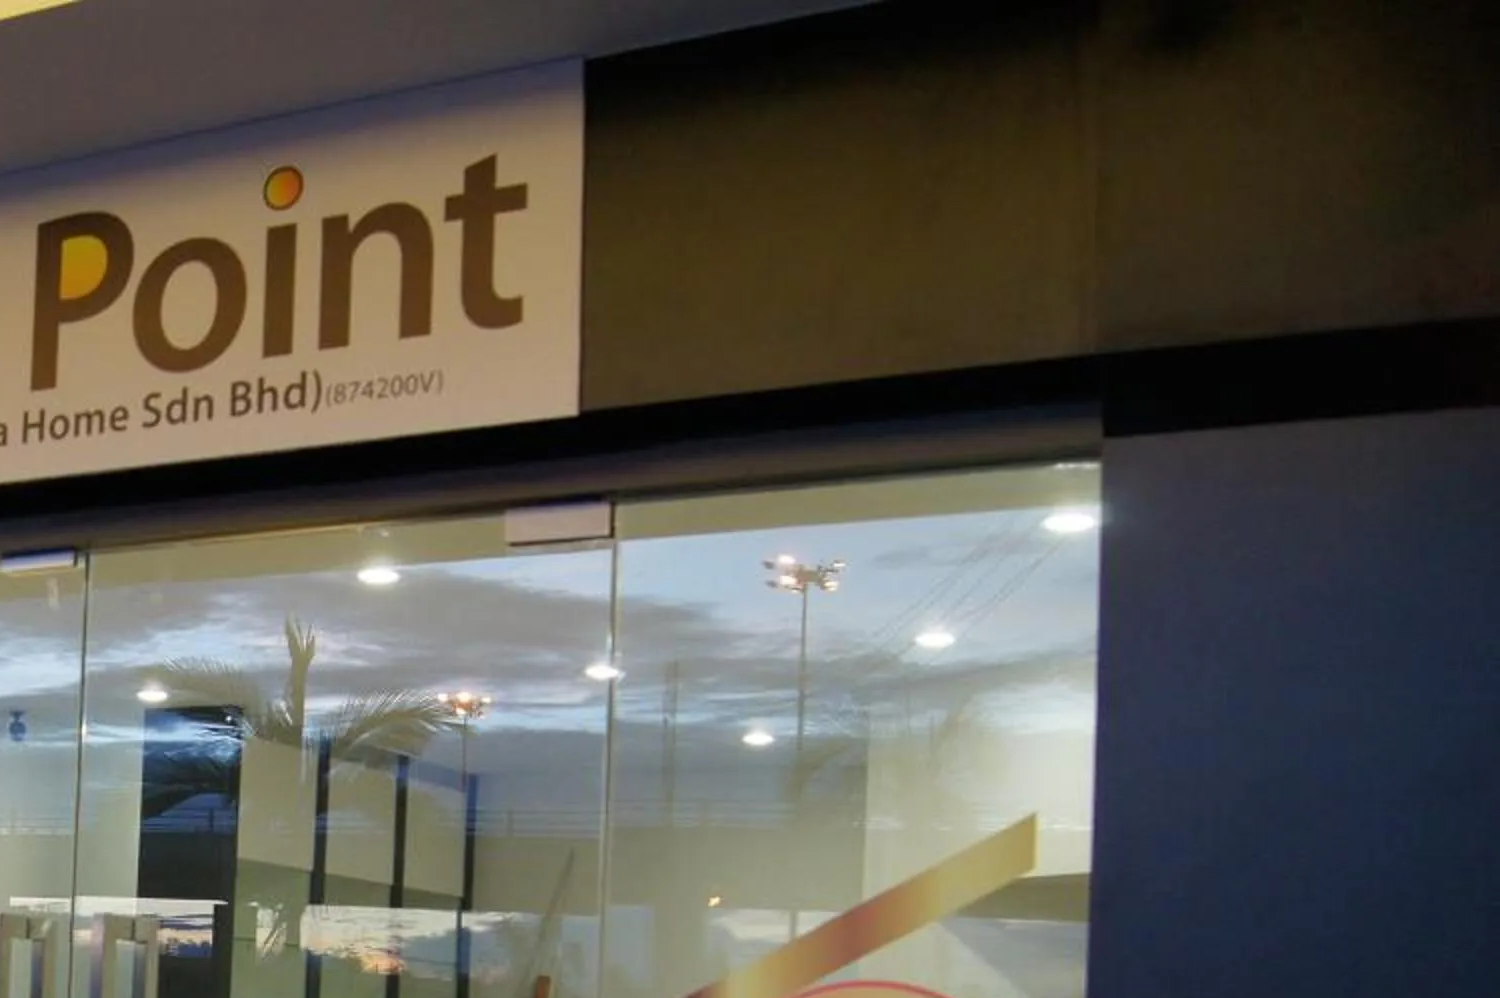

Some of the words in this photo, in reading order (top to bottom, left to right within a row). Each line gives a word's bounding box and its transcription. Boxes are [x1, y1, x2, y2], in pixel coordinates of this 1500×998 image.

[30, 153, 529, 392] Point
[21, 403, 129, 443] Home
[141, 387, 214, 428] Sdn
[229, 370, 322, 418] Bhd)
